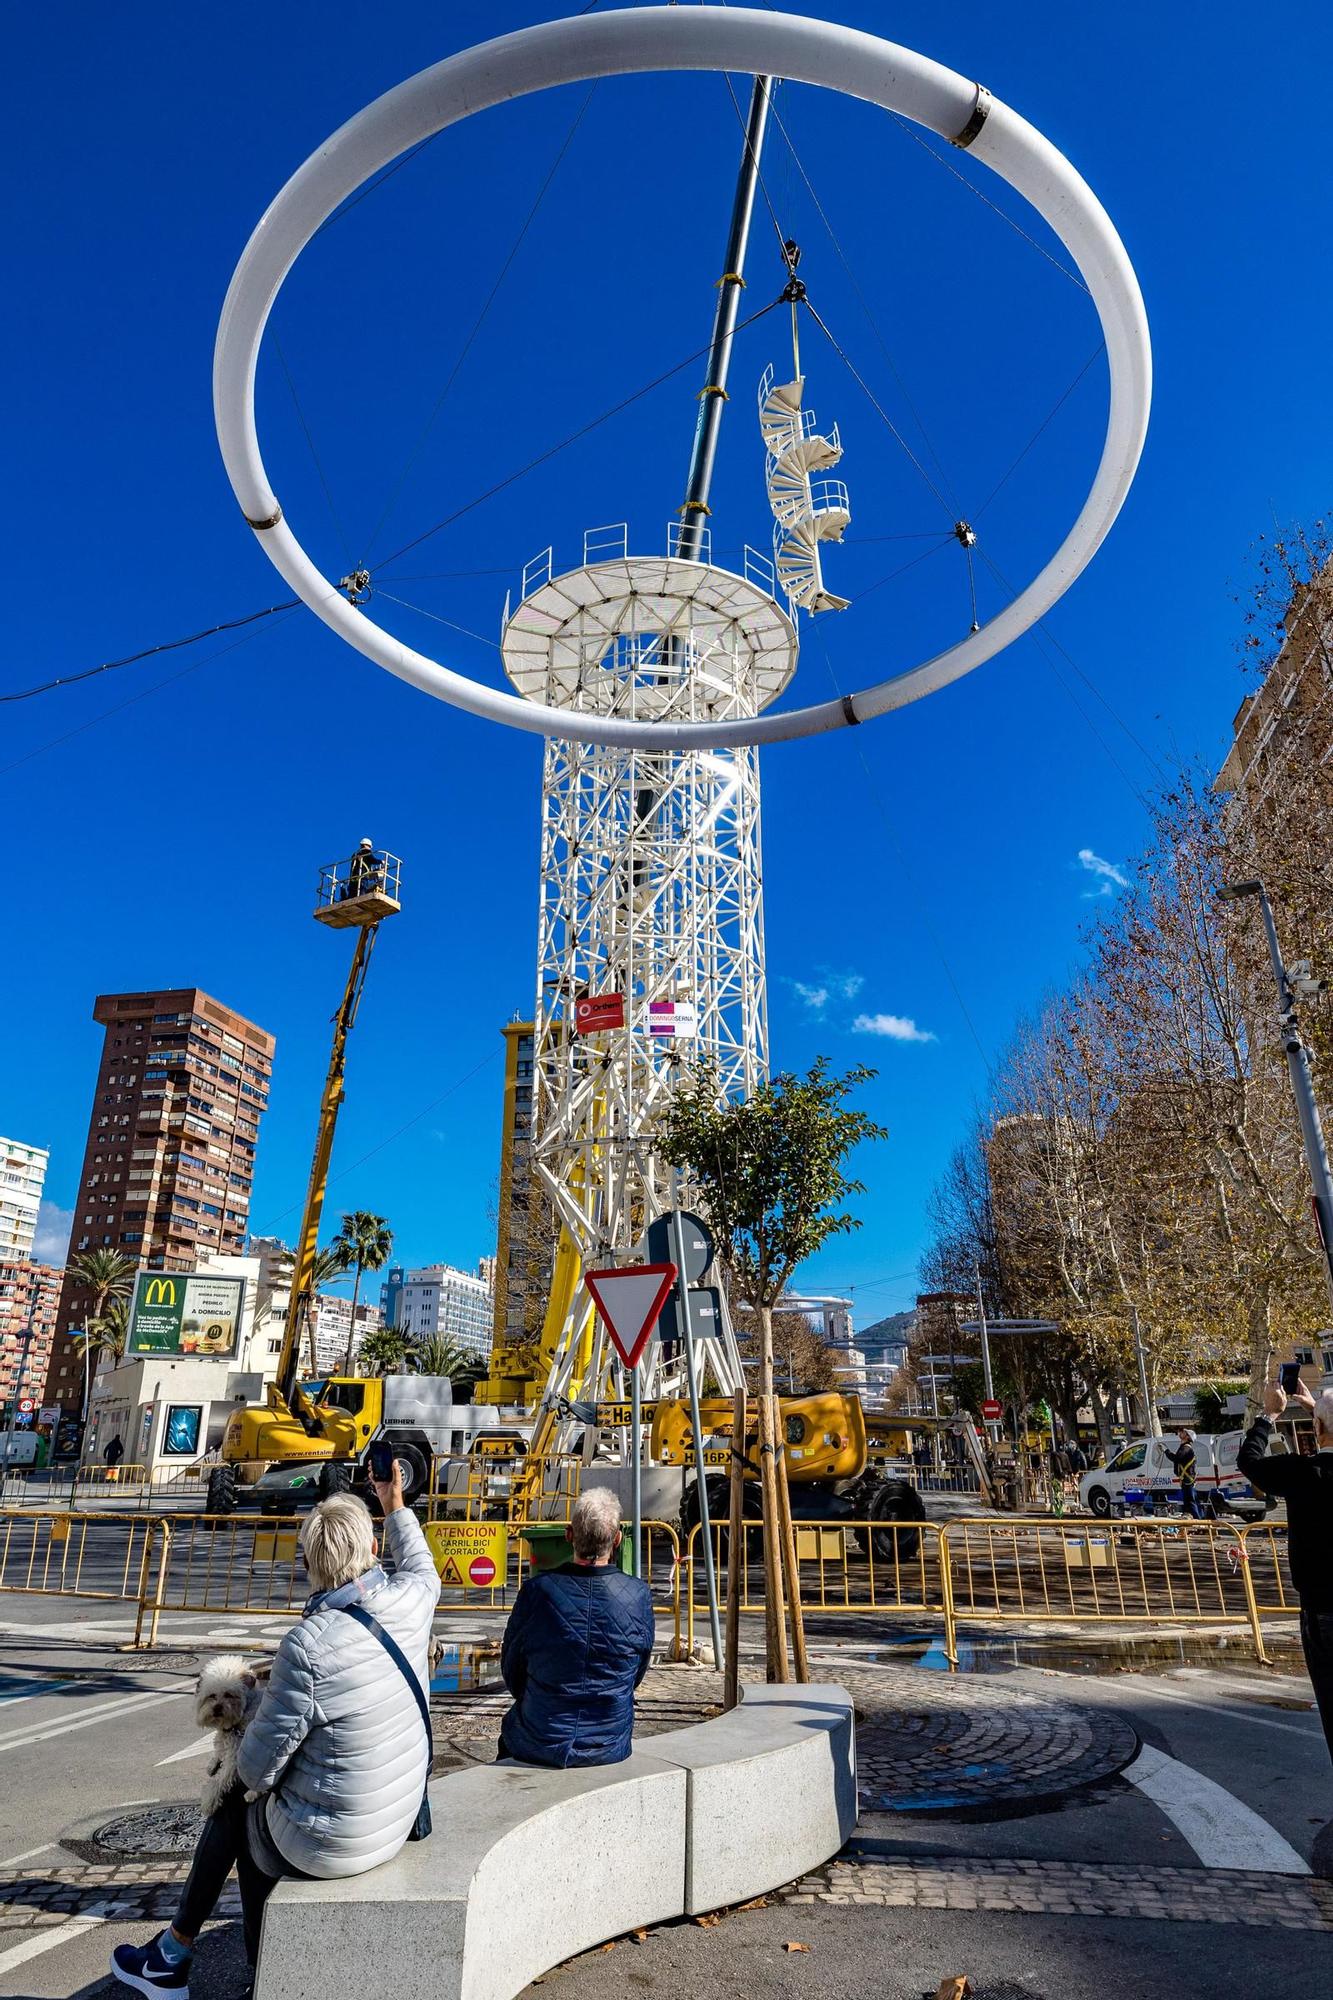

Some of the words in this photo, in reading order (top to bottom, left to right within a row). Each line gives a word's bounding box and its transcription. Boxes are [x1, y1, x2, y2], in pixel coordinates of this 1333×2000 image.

[613, 1406, 655, 1423] Halo
[685, 1452, 732, 1463] H16PX
[435, 1525, 497, 1538] ATENCIÓN
[441, 1539, 471, 1547] CARRIL
